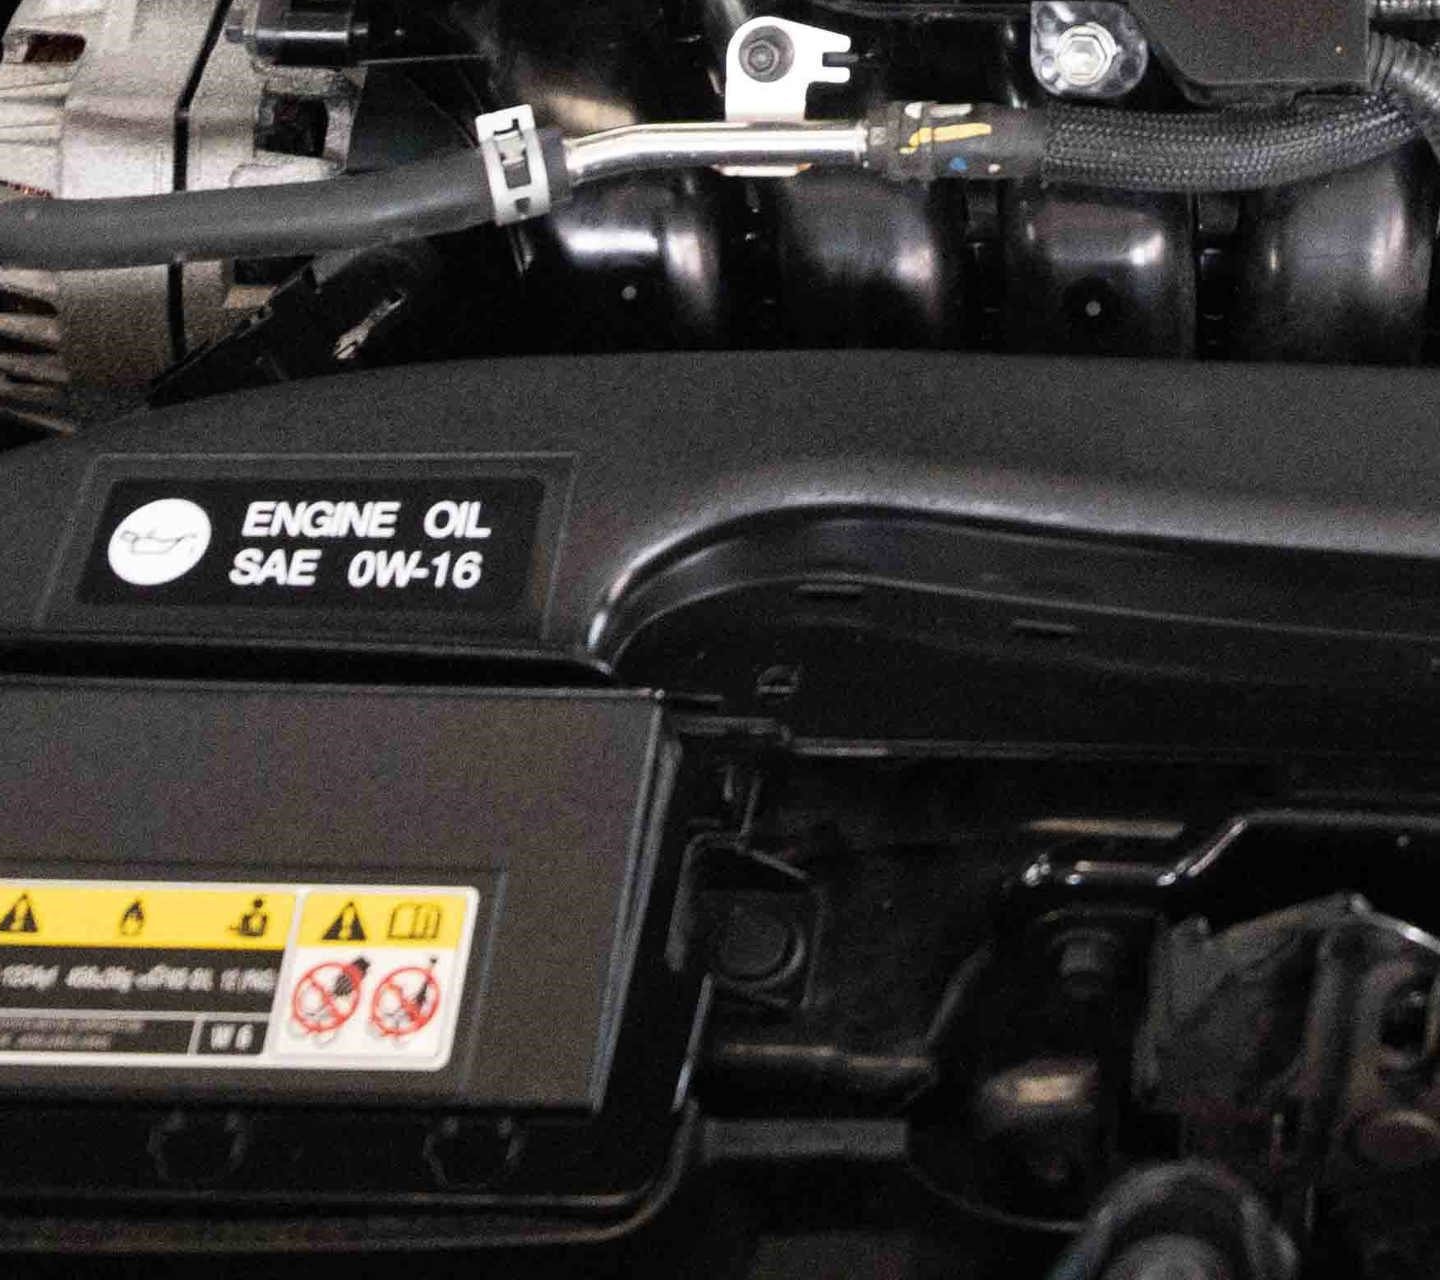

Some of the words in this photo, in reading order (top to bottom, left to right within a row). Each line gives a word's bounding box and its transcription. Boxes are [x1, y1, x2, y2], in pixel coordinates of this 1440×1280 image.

[241, 500, 400, 539] ENGINE
[422, 500, 492, 539] OIL
[228, 548, 322, 587] SAE
[346, 549, 484, 590] 0W-16
